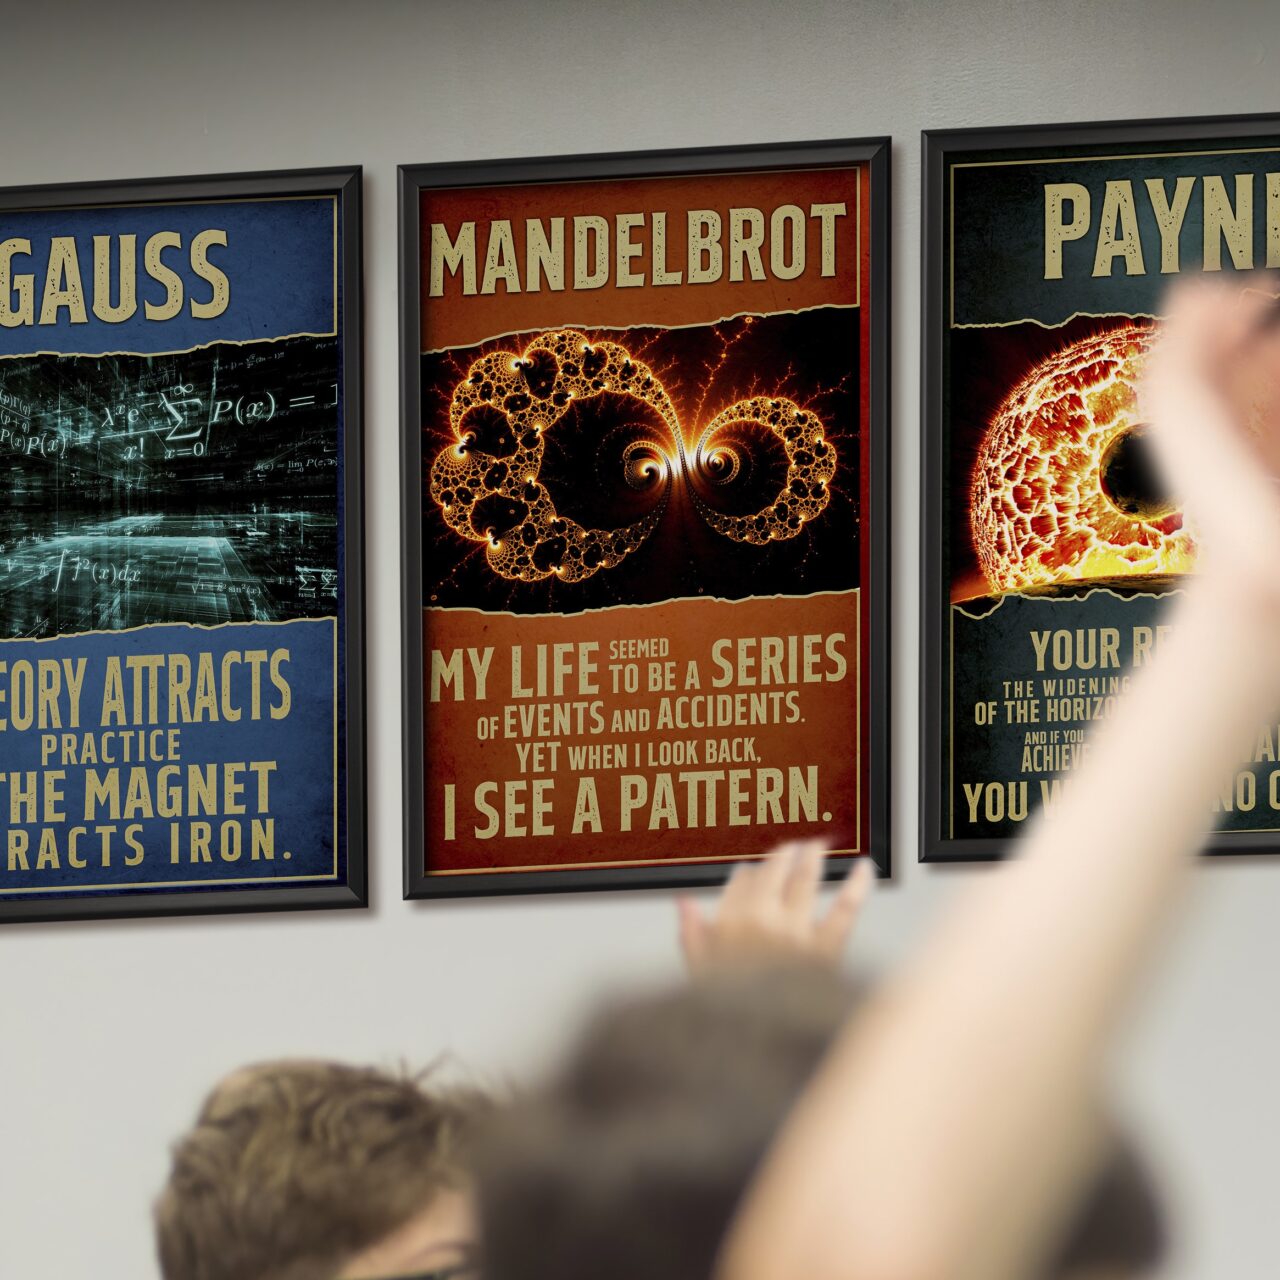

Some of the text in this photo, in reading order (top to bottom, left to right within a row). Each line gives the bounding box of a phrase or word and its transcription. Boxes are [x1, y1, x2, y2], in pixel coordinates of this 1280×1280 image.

[429, 202, 846, 297] MANDELBROT
[0, 229, 230, 327] GAUSS
[430, 641, 600, 702] MY LIFE
[609, 638, 669, 660] SEEMED
[711, 633, 847, 687] SERIES
[1030, 628, 1120, 671] YOUR
[101, 648, 291, 726] ATTRACTS
[609, 660, 700, 694] TO BE A
[1003, 675, 1131, 698] THE WIDENING
[477, 691, 806, 740] OF EVENTS AND ACCIDENTS.
[974, 696, 1119, 725] OF THE HORIZO
[41, 729, 181, 766] PRACTICE
[516, 737, 761, 773] YET WHEN I LOOK BACK,
[1025, 730, 1084, 744] AND IF YOU
[84, 760, 277, 821] MAGNET
[444, 766, 832, 840] I SEE A PATTERN.
[963, 781, 1028, 822] YOU
[8, 818, 292, 871] RACTS IRON.
